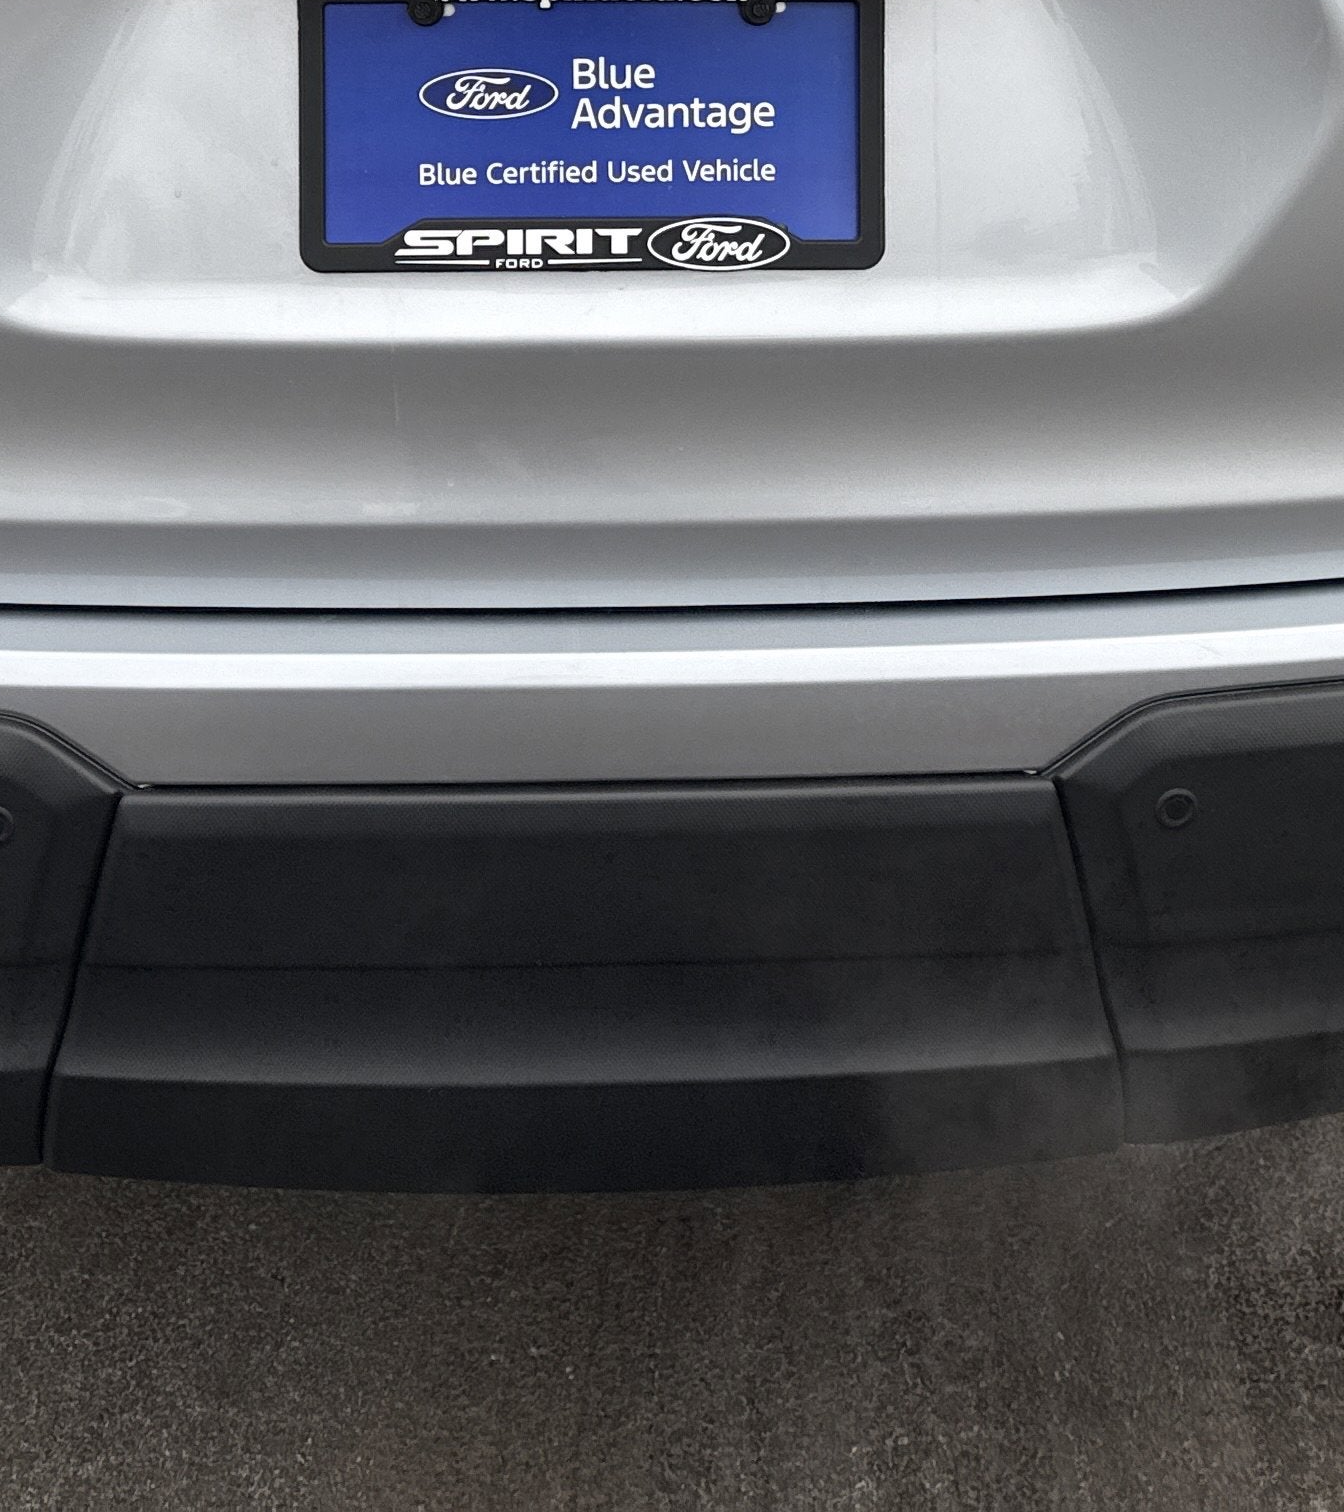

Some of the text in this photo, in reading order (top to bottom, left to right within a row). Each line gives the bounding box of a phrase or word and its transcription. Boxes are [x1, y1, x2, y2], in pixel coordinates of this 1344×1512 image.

[572, 57, 655, 90] Blue
[445, 75, 532, 111] Ford
[571, 96, 775, 135] Advantage
[419, 158, 776, 185] Blue Certified Used Vehicle
[394, 227, 643, 256] SPIRIT
[671, 223, 765, 262] Ford
[495, 258, 544, 268] FORD
